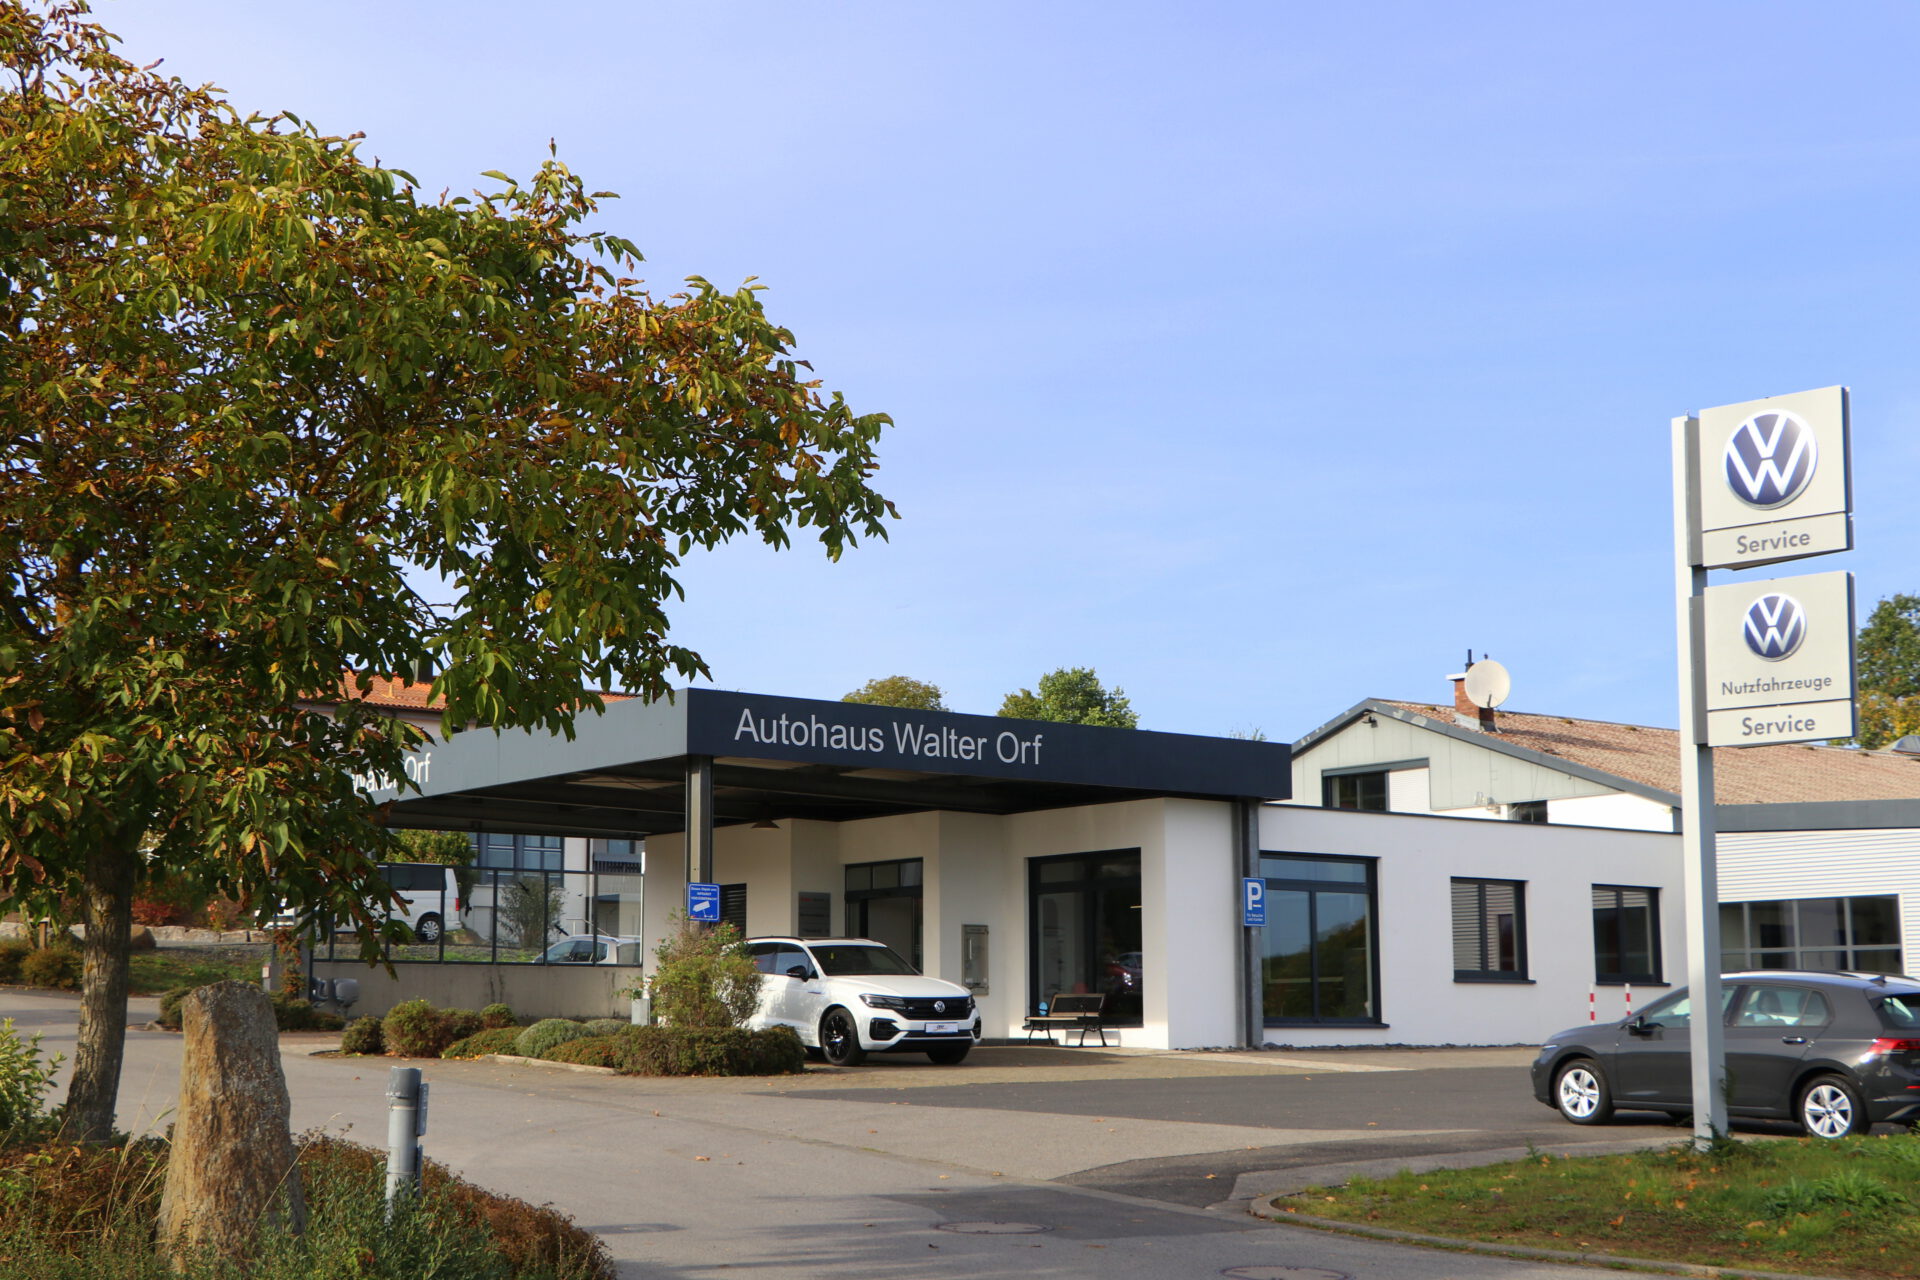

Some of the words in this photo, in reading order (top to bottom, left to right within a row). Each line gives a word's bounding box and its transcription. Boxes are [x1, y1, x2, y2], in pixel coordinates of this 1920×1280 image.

[1736, 531, 1811, 555] Service
[1721, 675, 1833, 696] Nutzfahrzeuge
[733, 708, 885, 753] Autohaus
[893, 721, 988, 761] Walter
[996, 731, 1043, 765] Orf
[1741, 714, 1816, 737] Service
[404, 752, 431, 783] Orf
[1247, 881, 1262, 911] P
